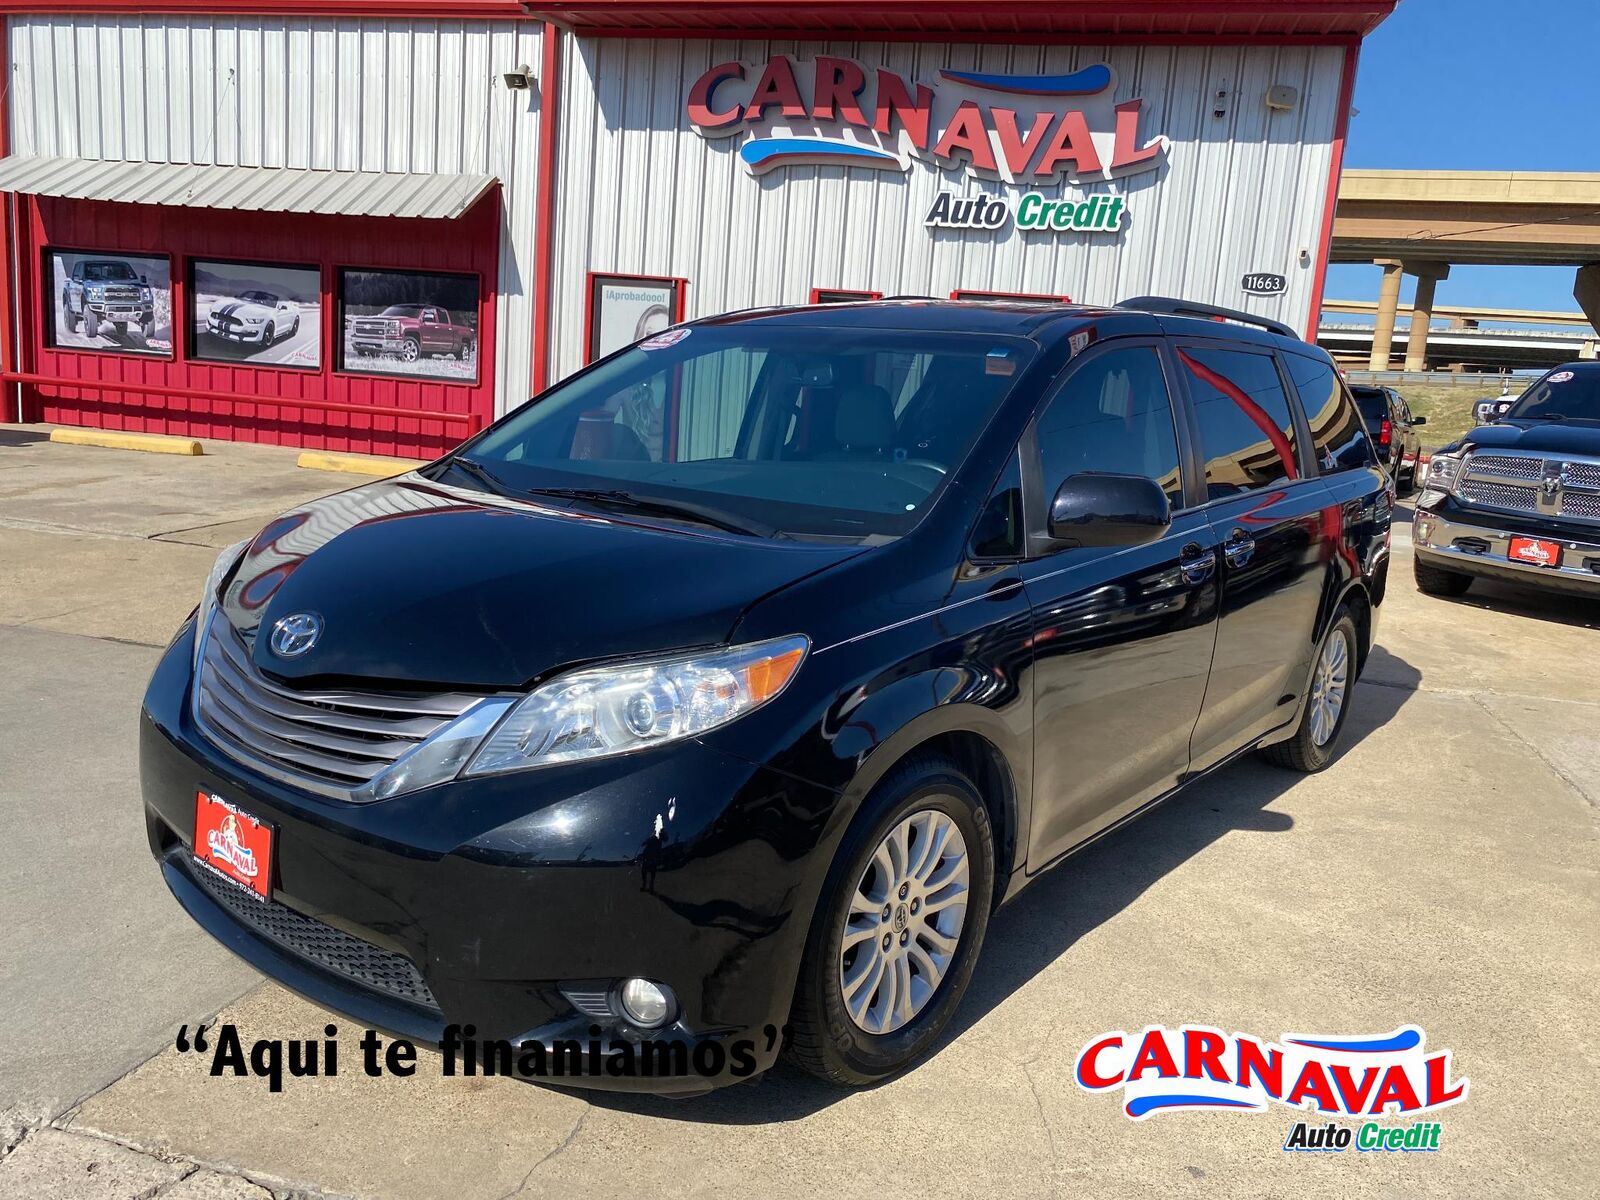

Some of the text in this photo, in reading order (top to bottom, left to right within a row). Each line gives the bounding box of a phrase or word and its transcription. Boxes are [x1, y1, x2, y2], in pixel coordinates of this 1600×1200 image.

[687, 54, 1165, 176] CARNAVAL
[925, 193, 1124, 229] Auto Credit
[1246, 275, 1280, 290] 11663
[207, 830, 257, 873] CARNAVAL
